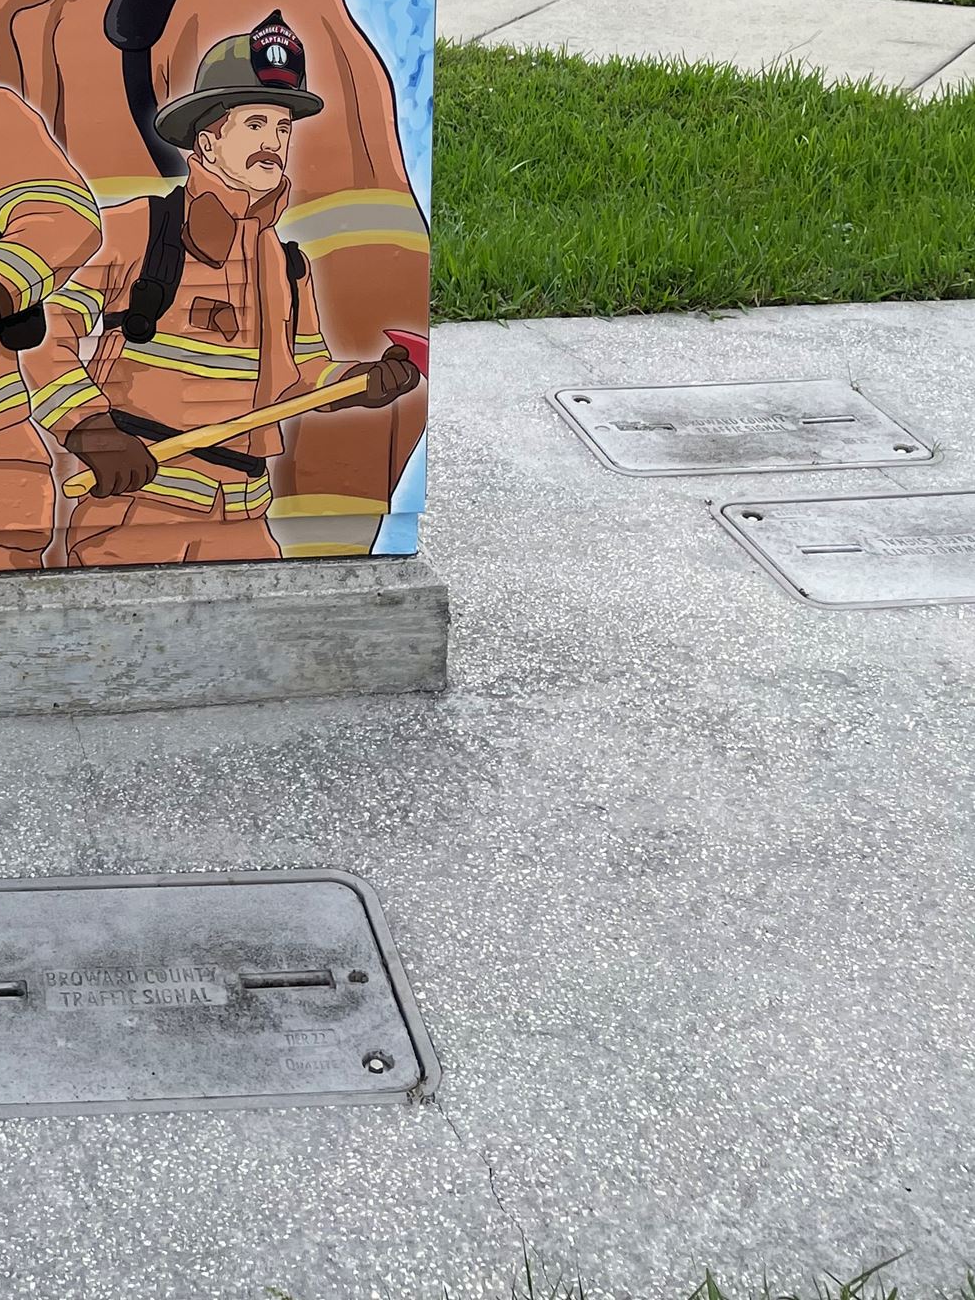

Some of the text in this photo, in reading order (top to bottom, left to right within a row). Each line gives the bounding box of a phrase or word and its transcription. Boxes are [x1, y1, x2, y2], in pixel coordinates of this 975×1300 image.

[260, 36, 289, 46] CAPTAIN
[697, 423, 788, 434] TRAFFIC SIGNAL
[927, 534, 975, 546] RAFFIC
[45, 966, 217, 988] BROWARD COUNTY
[59, 987, 212, 1008] TRAFFIC SIGNAL
[284, 1032, 329, 1046] TIER 22
